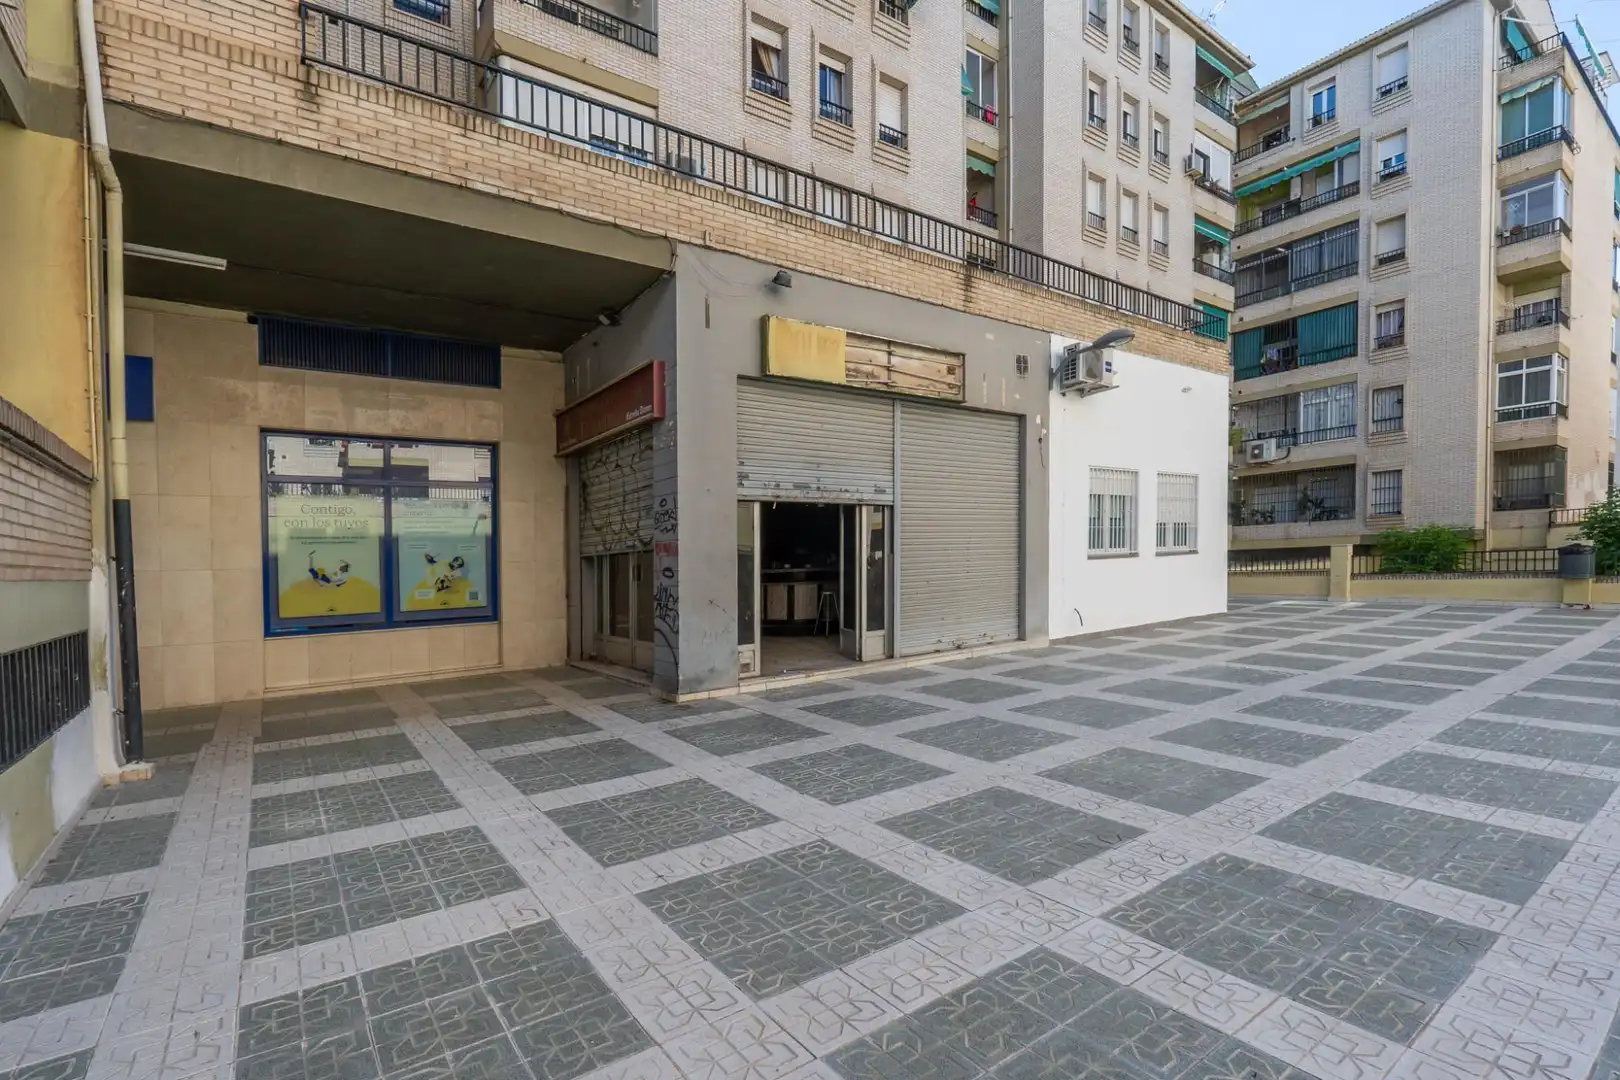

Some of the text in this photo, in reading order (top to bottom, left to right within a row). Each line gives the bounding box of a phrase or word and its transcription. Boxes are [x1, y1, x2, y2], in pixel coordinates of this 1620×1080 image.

[301, 504, 356, 516] Contigo,
[284, 519, 308, 528] con
[311, 516, 331, 528] los
